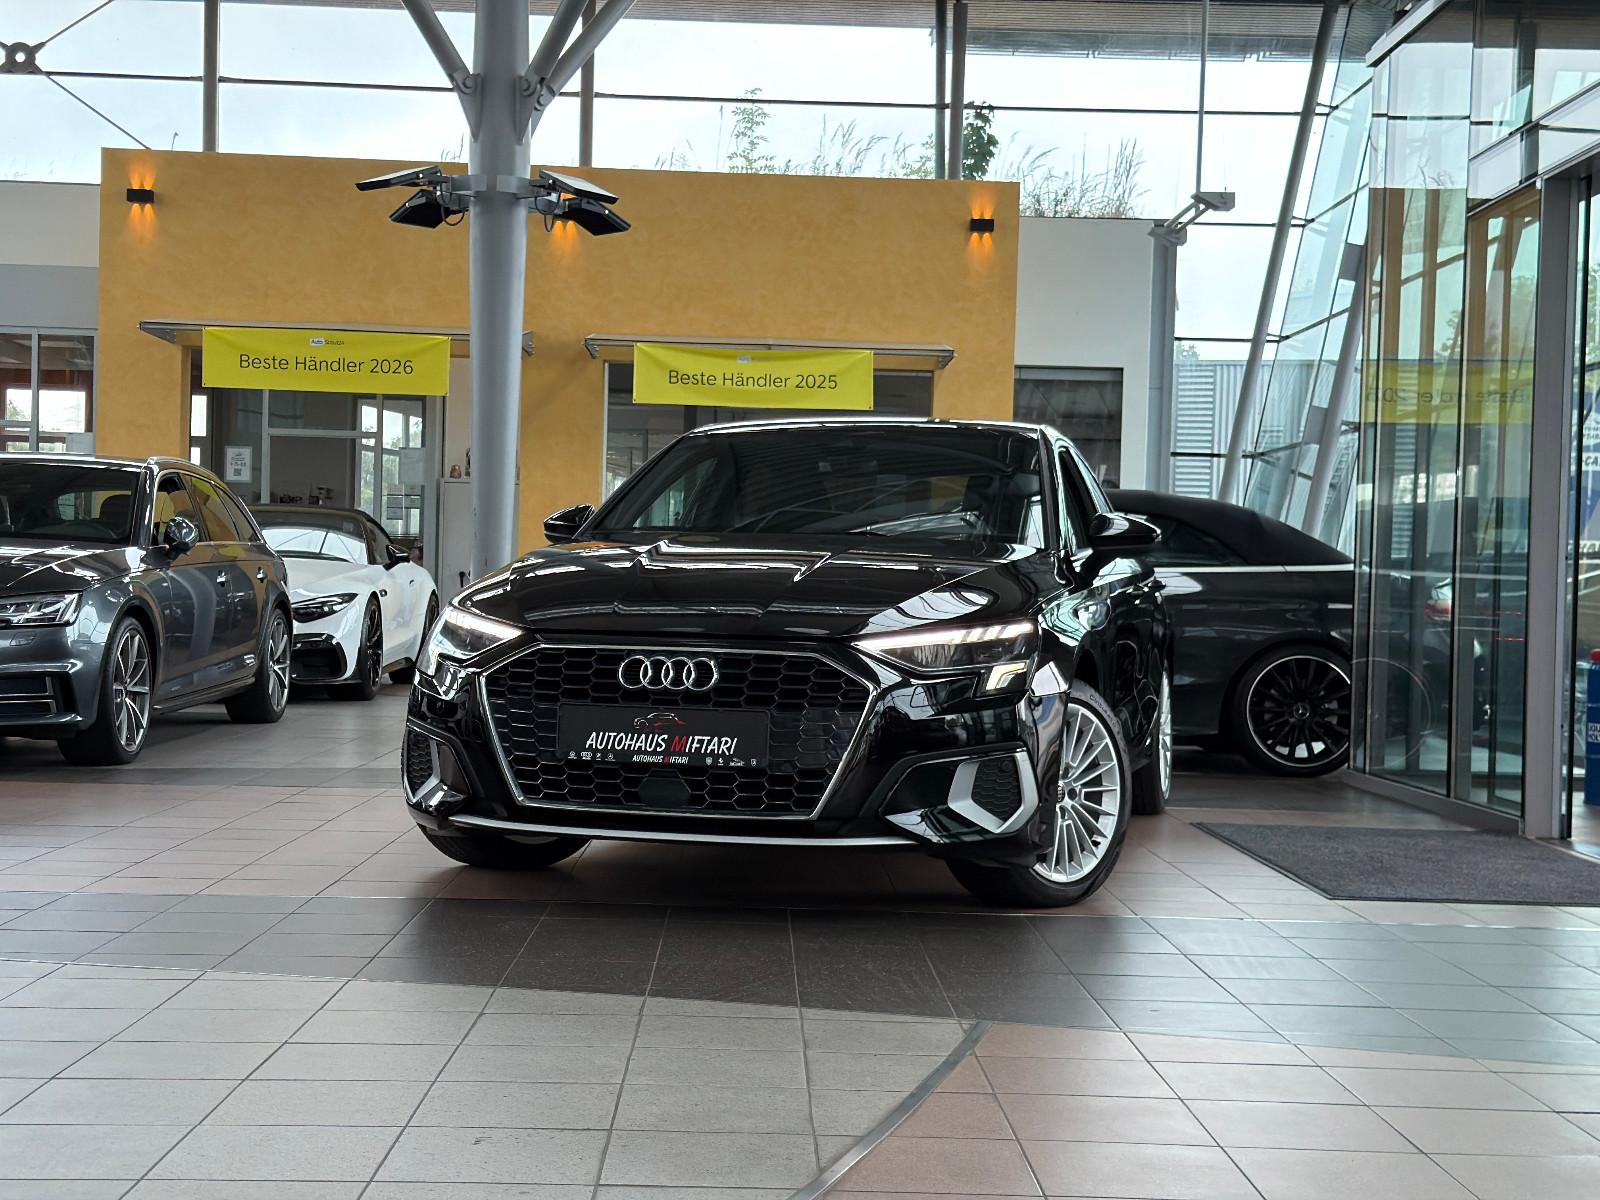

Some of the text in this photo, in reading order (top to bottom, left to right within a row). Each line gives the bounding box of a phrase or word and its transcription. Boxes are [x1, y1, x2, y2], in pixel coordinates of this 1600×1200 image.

[239, 353, 414, 375] Beste Händler 2026
[668, 369, 838, 390] Beste Händler 2025
[585, 731, 738, 756] AUTOHAUS MIFTARI
[631, 754, 689, 765] AUTOHAUS MIFTARI
